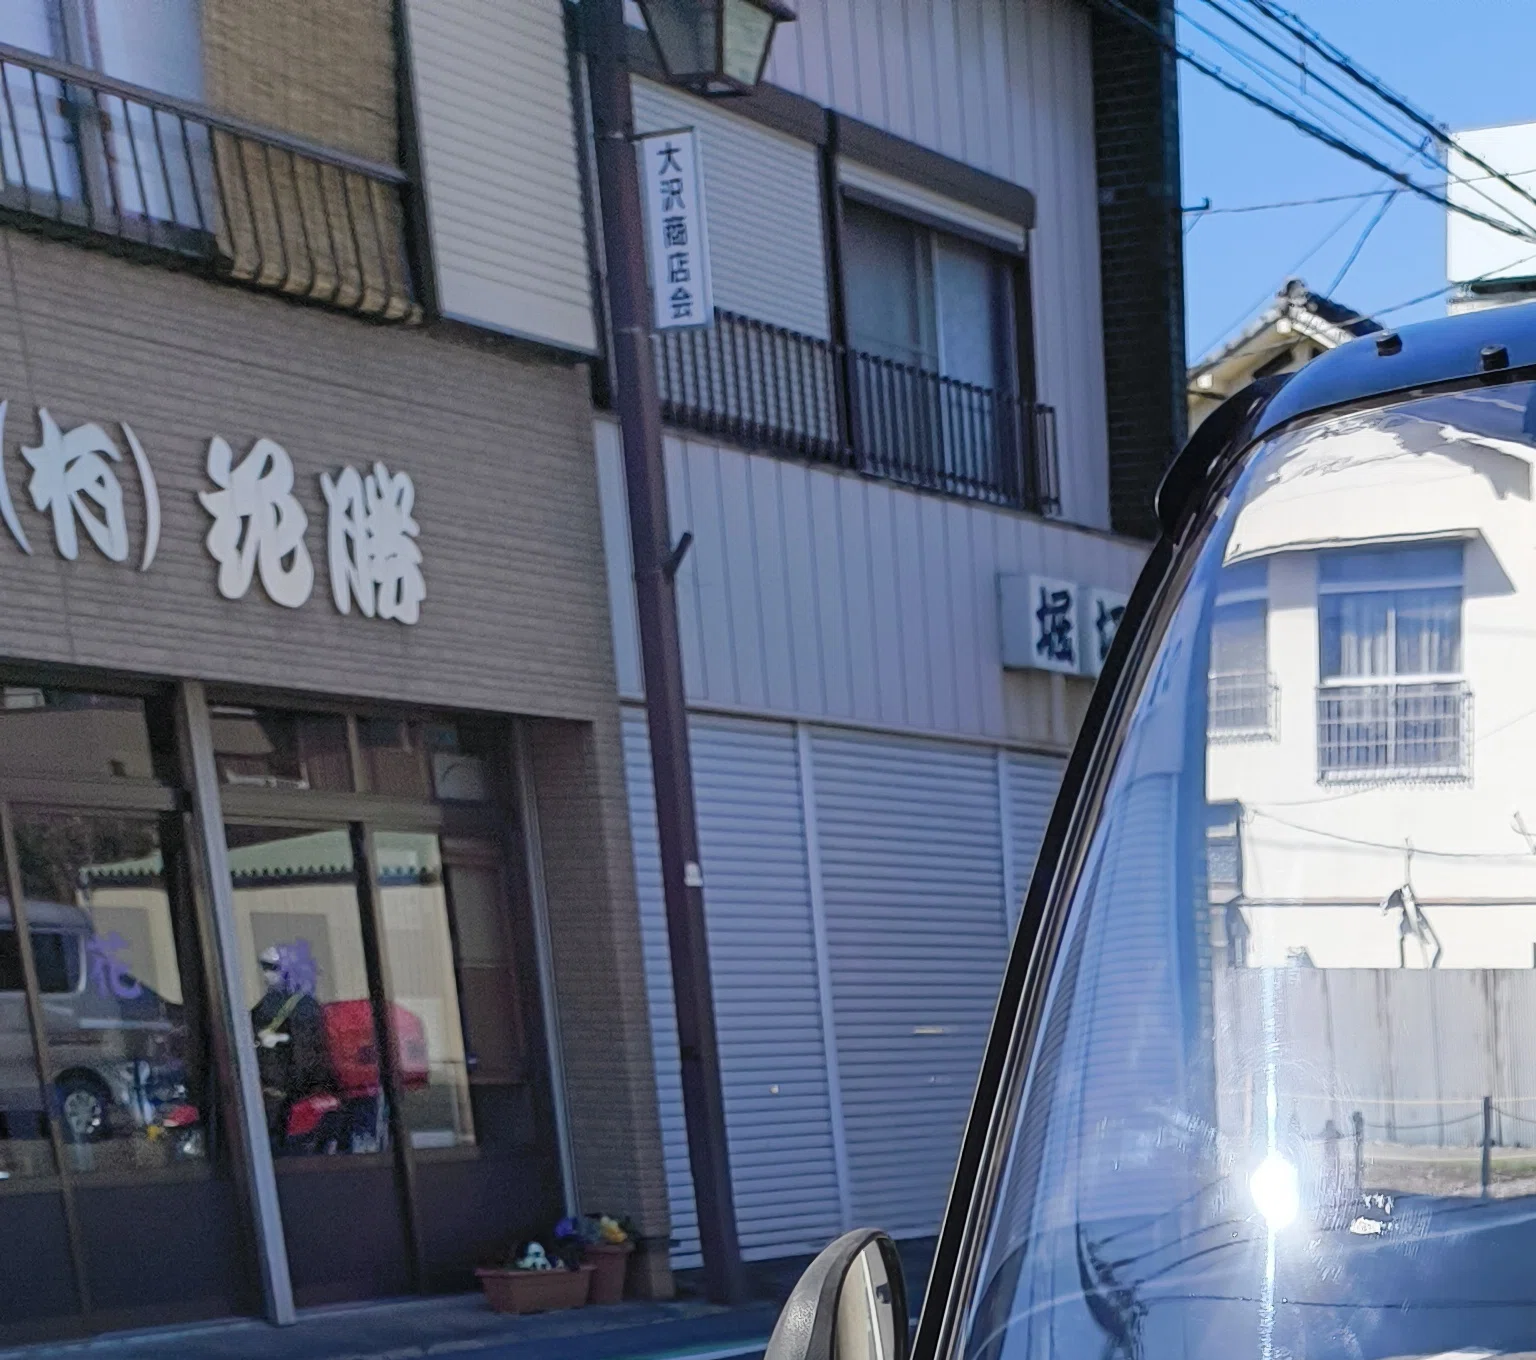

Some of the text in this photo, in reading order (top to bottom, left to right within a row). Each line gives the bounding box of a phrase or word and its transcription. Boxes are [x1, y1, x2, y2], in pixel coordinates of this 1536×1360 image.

[656, 141, 693, 320] 大沢商店会
